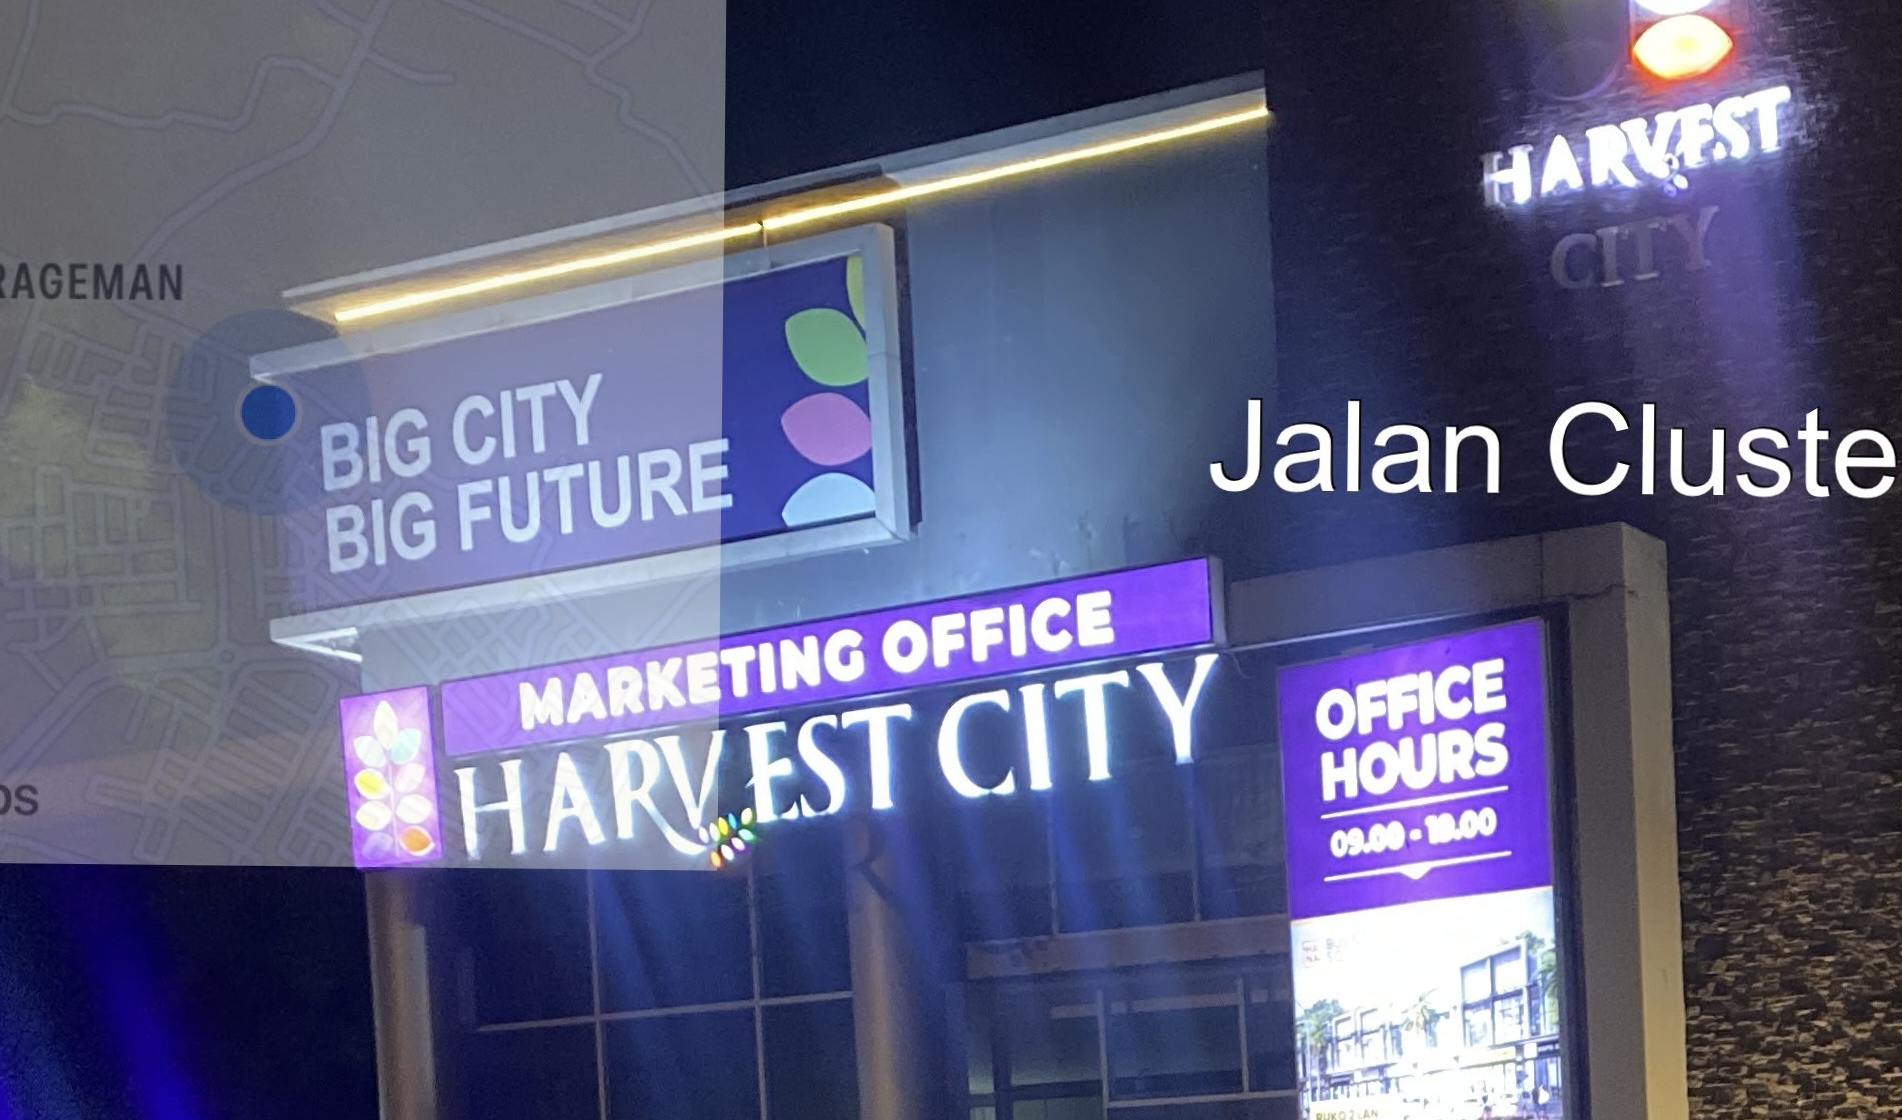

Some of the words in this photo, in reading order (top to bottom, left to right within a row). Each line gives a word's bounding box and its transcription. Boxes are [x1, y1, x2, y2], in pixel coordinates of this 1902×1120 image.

[1482, 85, 1791, 209] HARVEST
[1551, 205, 1720, 290] CITY
[320, 407, 431, 492] BIG
[453, 373, 604, 467] CITY
[325, 489, 436, 574] BIG
[460, 438, 733, 552] FUTURE
[517, 629, 866, 732] MARKETING
[881, 590, 1114, 671] OFFICE
[1315, 657, 1508, 741] OFFICE
[453, 704, 914, 861] HARVEST
[937, 653, 1220, 800] CITY
[1320, 722, 1510, 802] HOURS
[1329, 820, 1406, 858] 09.00
